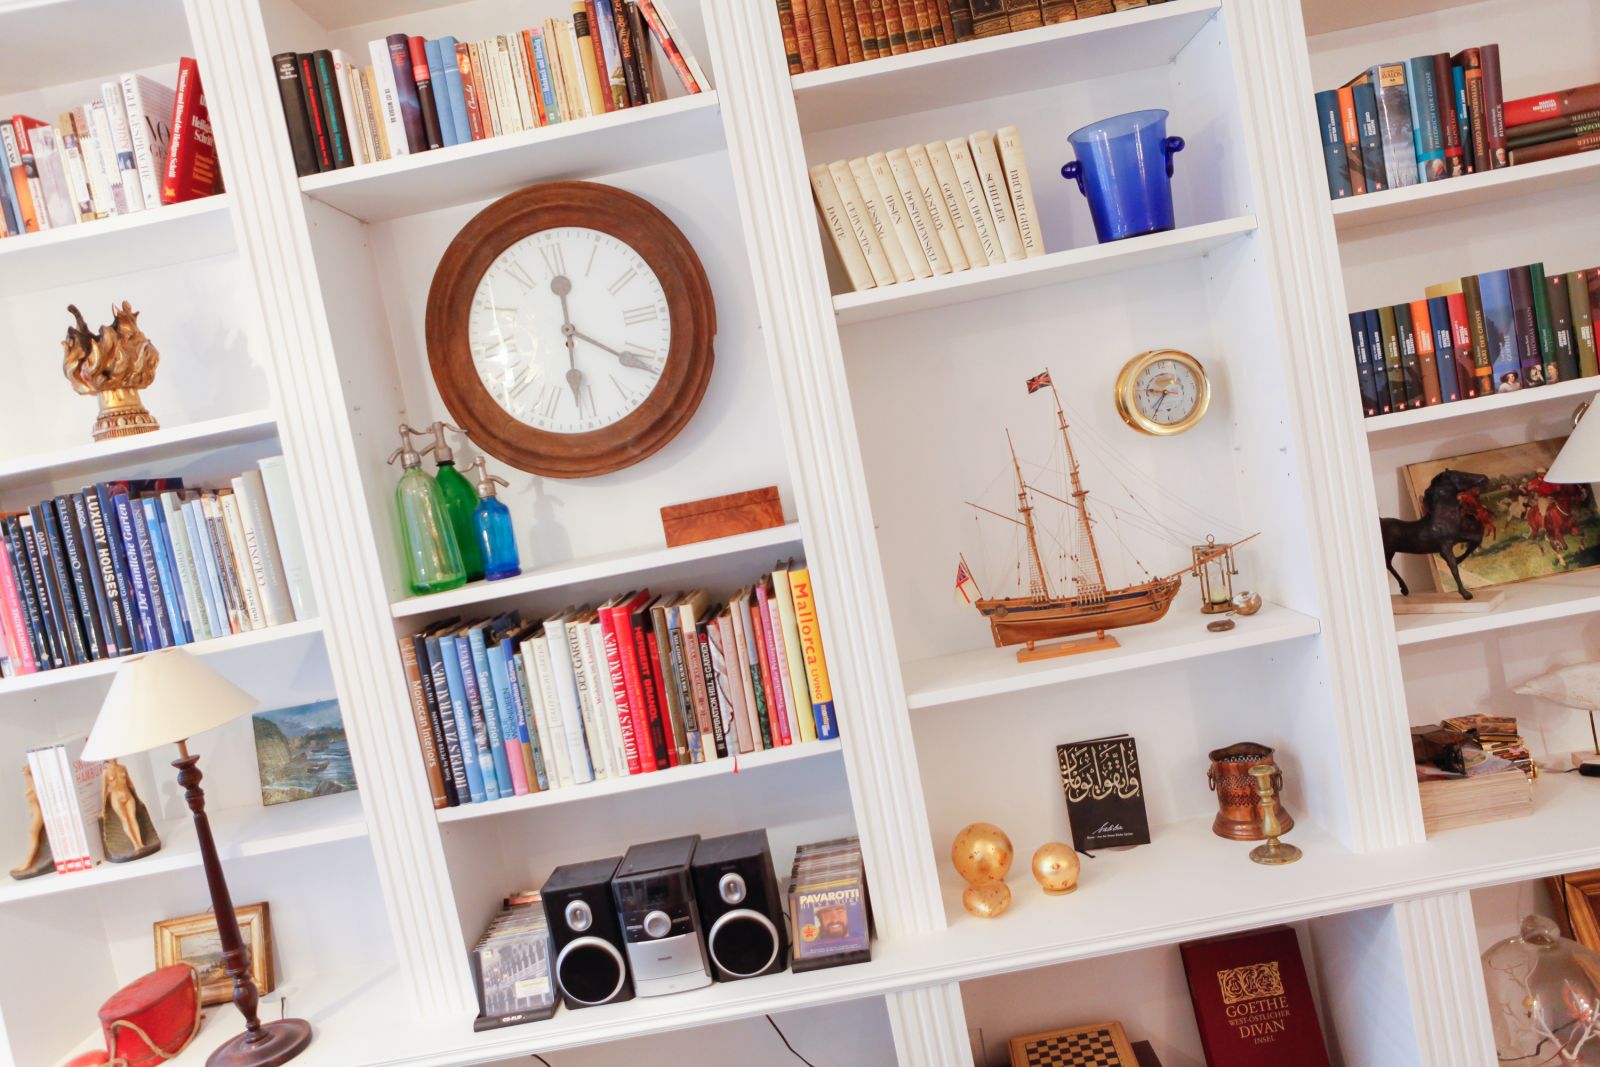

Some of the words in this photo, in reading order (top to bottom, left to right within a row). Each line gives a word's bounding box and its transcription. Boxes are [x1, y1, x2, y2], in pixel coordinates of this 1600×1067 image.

[619, 36, 632, 58] Risse
[122, 76, 137, 112] VOGUE
[0, 126, 17, 164] FLOW
[884, 193, 902, 224] IBSEN
[923, 185, 943, 232] NESTROY
[942, 181, 962, 224] GOETHE
[984, 171, 1005, 225] SCHILLER
[1008, 168, 1026, 212] BRÜDER
[1018, 212, 1034, 250] GRIMM
[825, 204, 845, 240] DANTE
[846, 200, 872, 256] CERVANTES
[865, 198, 886, 240] LESSING
[57, 497, 81, 571] ORIENTALISTES
[116, 502, 134, 542] Garten
[36, 530, 48, 557] QATAR
[85, 494, 106, 544] LUXURY
[97, 546, 119, 599] HOUSES
[110, 599, 123, 627] COUNTRY
[245, 526, 266, 587] COLONIAL
[8, 520, 39, 623] BEGEGNUNGEN
[74, 571, 83, 583] des
[116, 571, 127, 596] GASSER
[125, 541, 144, 589] sinnliche
[138, 538, 161, 594] GARTEN
[77, 584, 91, 617] L'univers
[136, 589, 149, 611] Der
[457, 642, 470, 668] WELT
[563, 625, 583, 669] GARTEN
[602, 630, 625, 688] TRÄUMEN
[700, 641, 712, 672] GARDEN
[792, 583, 817, 664] Mallorca
[809, 667, 824, 701] LIVING
[429, 660, 452, 718] TRÄUMEN
[477, 669, 494, 708] Seaside
[573, 669, 587, 692] DER
[634, 624, 649, 676] HERBERT
[643, 677, 658, 722] BRANDL
[707, 679, 716, 696] HILL
[452, 698, 469, 739] Interiors
[614, 687, 630, 715] ZUM
[710, 696, 723, 741] INSPIRATION
[411, 679, 430, 728] Moroccan
[421, 727, 438, 768] Interiors
[441, 717, 457, 744] ZUM
[485, 707, 501, 748] Interiors
[619, 713, 639, 761] HOTELS
[447, 743, 466, 790] HOTELS
[460, 739, 473, 765] Paris
[799, 888, 860, 906] PAVAROTTI
[1225, 996, 1289, 1018] GOETHE
[1229, 1009, 1291, 1026] WEST-ÖSTLICHER
[1239, 1020, 1286, 1038] DIVAN
[1254, 1036, 1276, 1045] INSEL
